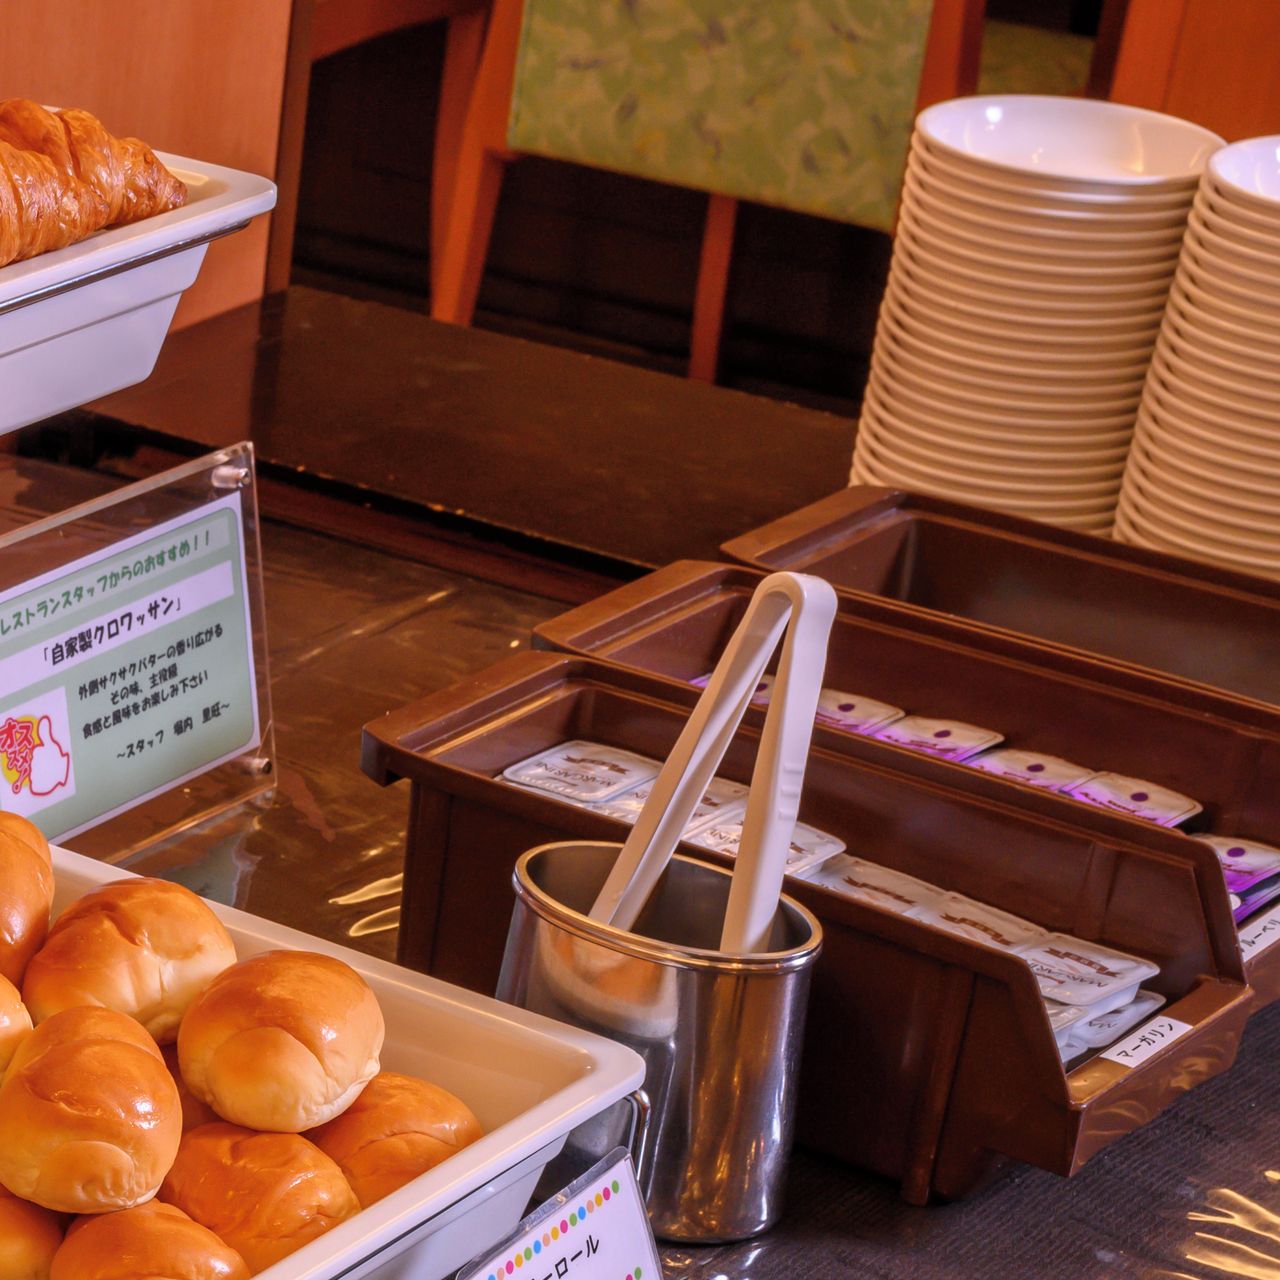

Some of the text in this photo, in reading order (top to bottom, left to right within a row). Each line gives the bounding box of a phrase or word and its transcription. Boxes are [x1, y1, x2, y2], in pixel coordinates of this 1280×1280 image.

[42, 596, 182, 665] 「自家製クロワッサン」
[1117, 1022, 1174, 1057] マーガリン
